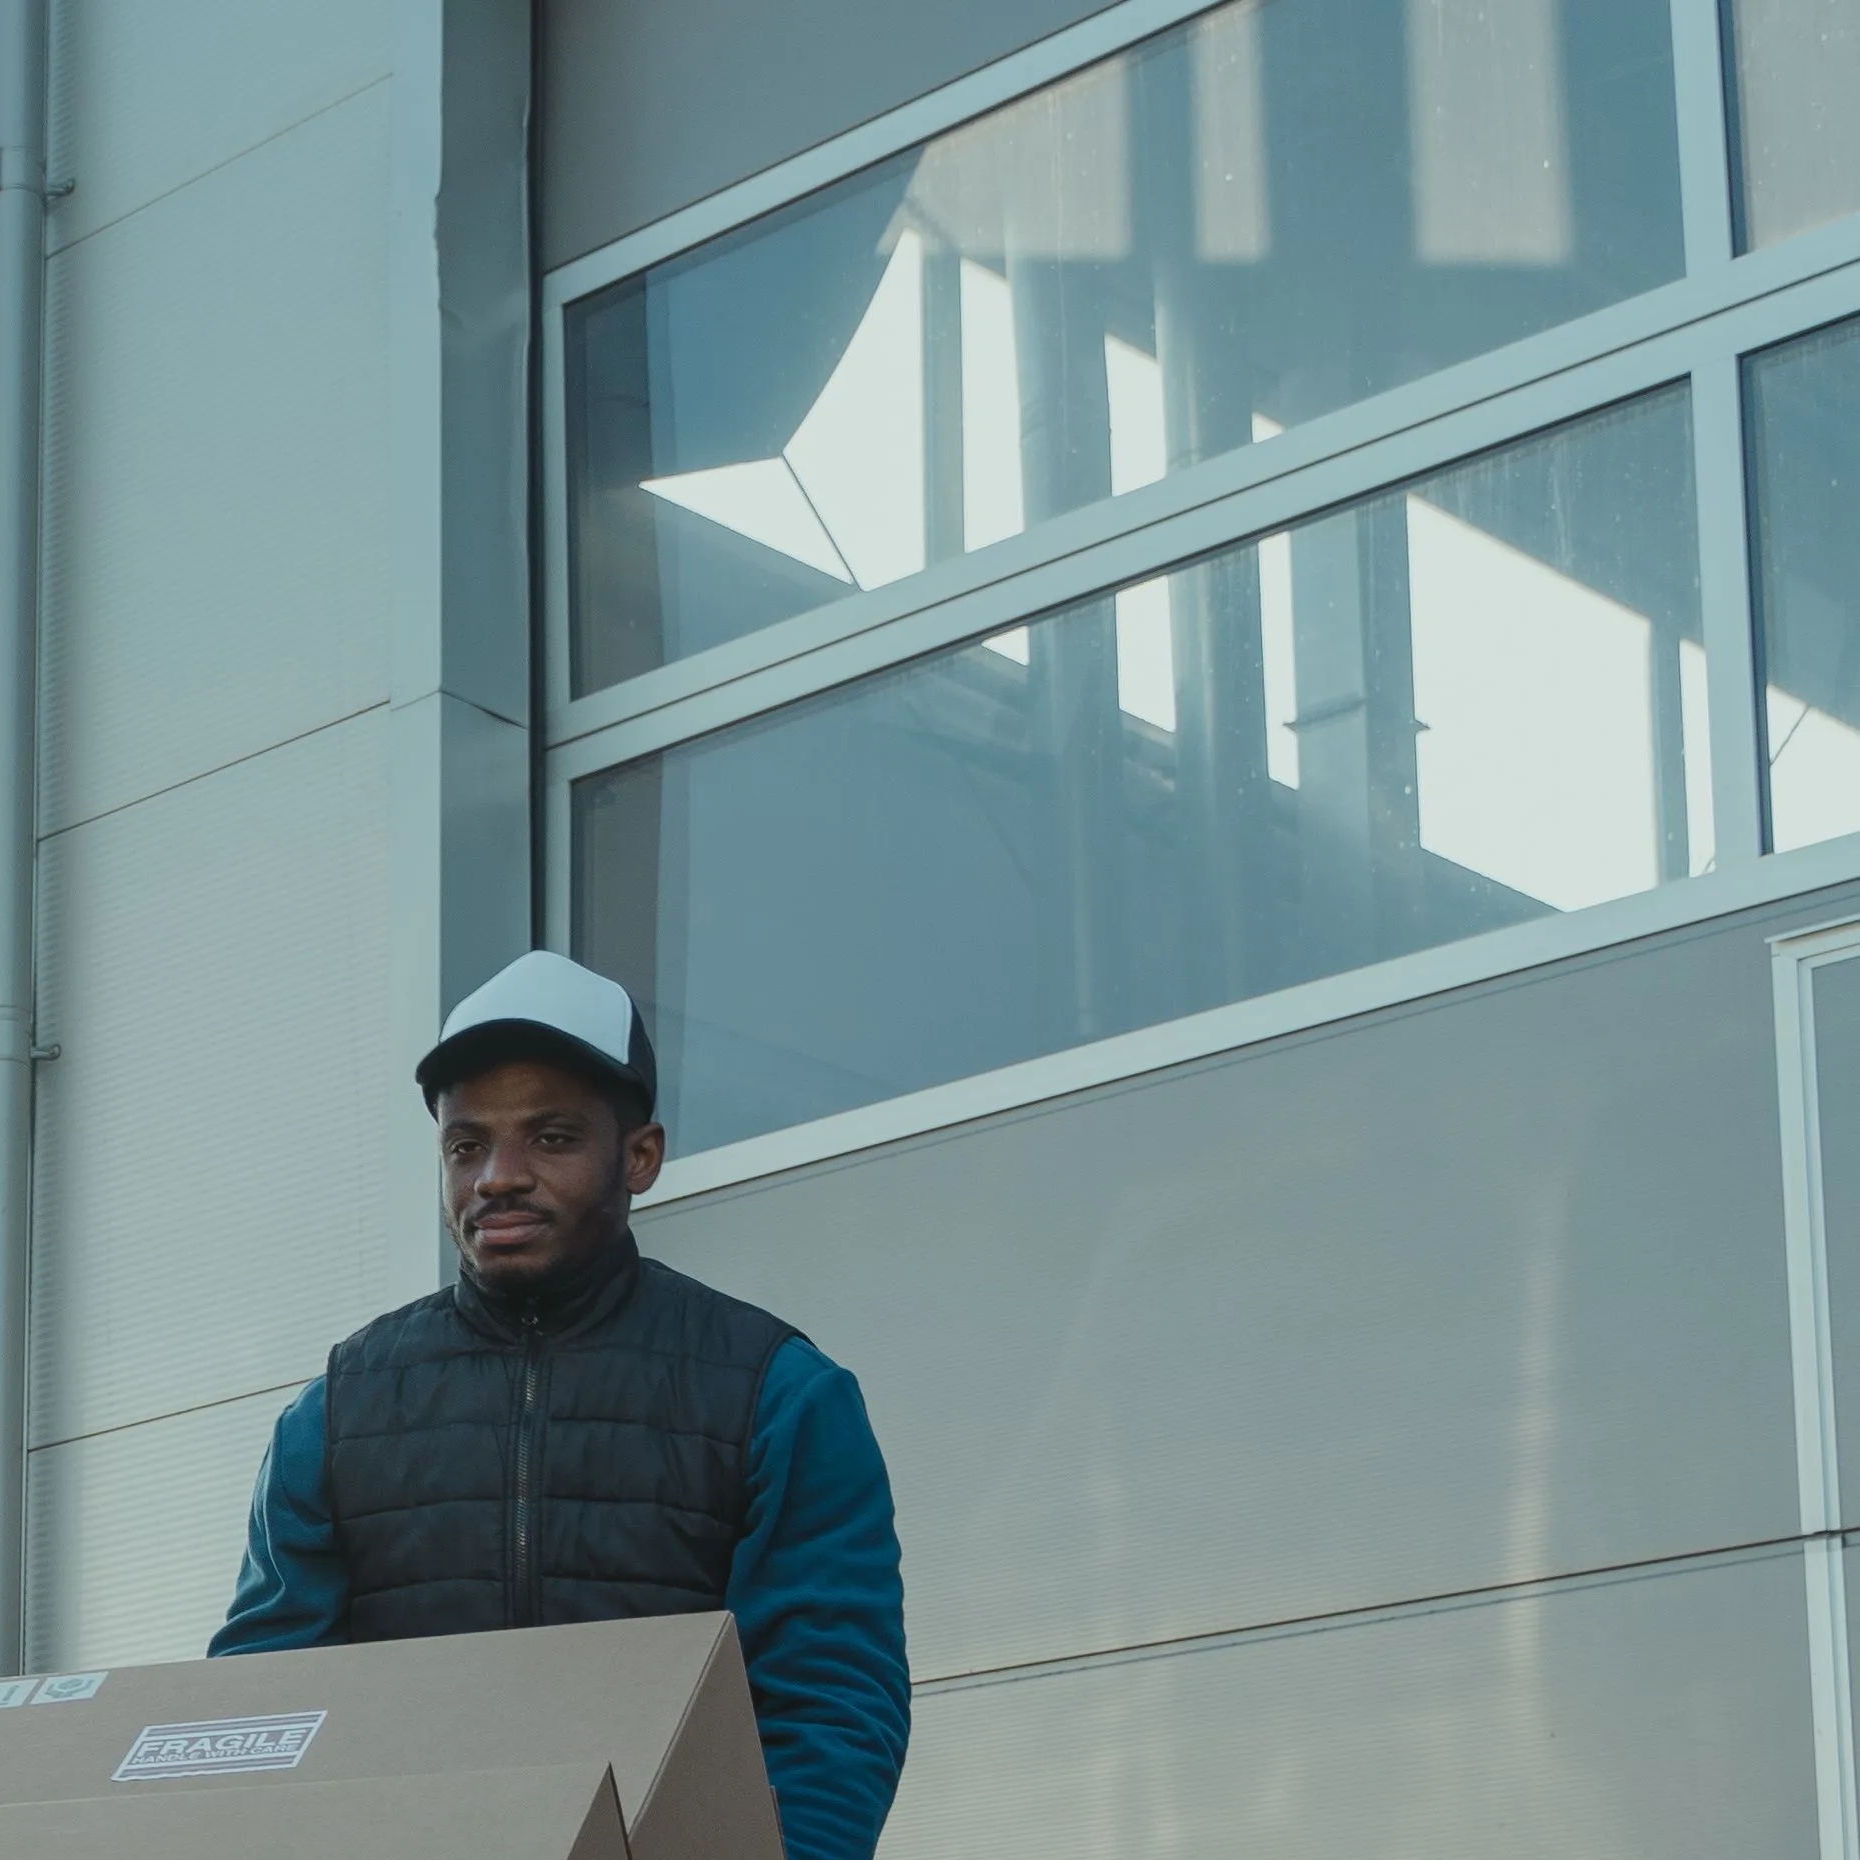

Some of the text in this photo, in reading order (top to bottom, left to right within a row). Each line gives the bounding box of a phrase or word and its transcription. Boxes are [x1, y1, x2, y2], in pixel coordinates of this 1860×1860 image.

[131, 1743, 300, 1764] HANDLE WITH CARE
[135, 1729, 307, 1757] FRAGILE
